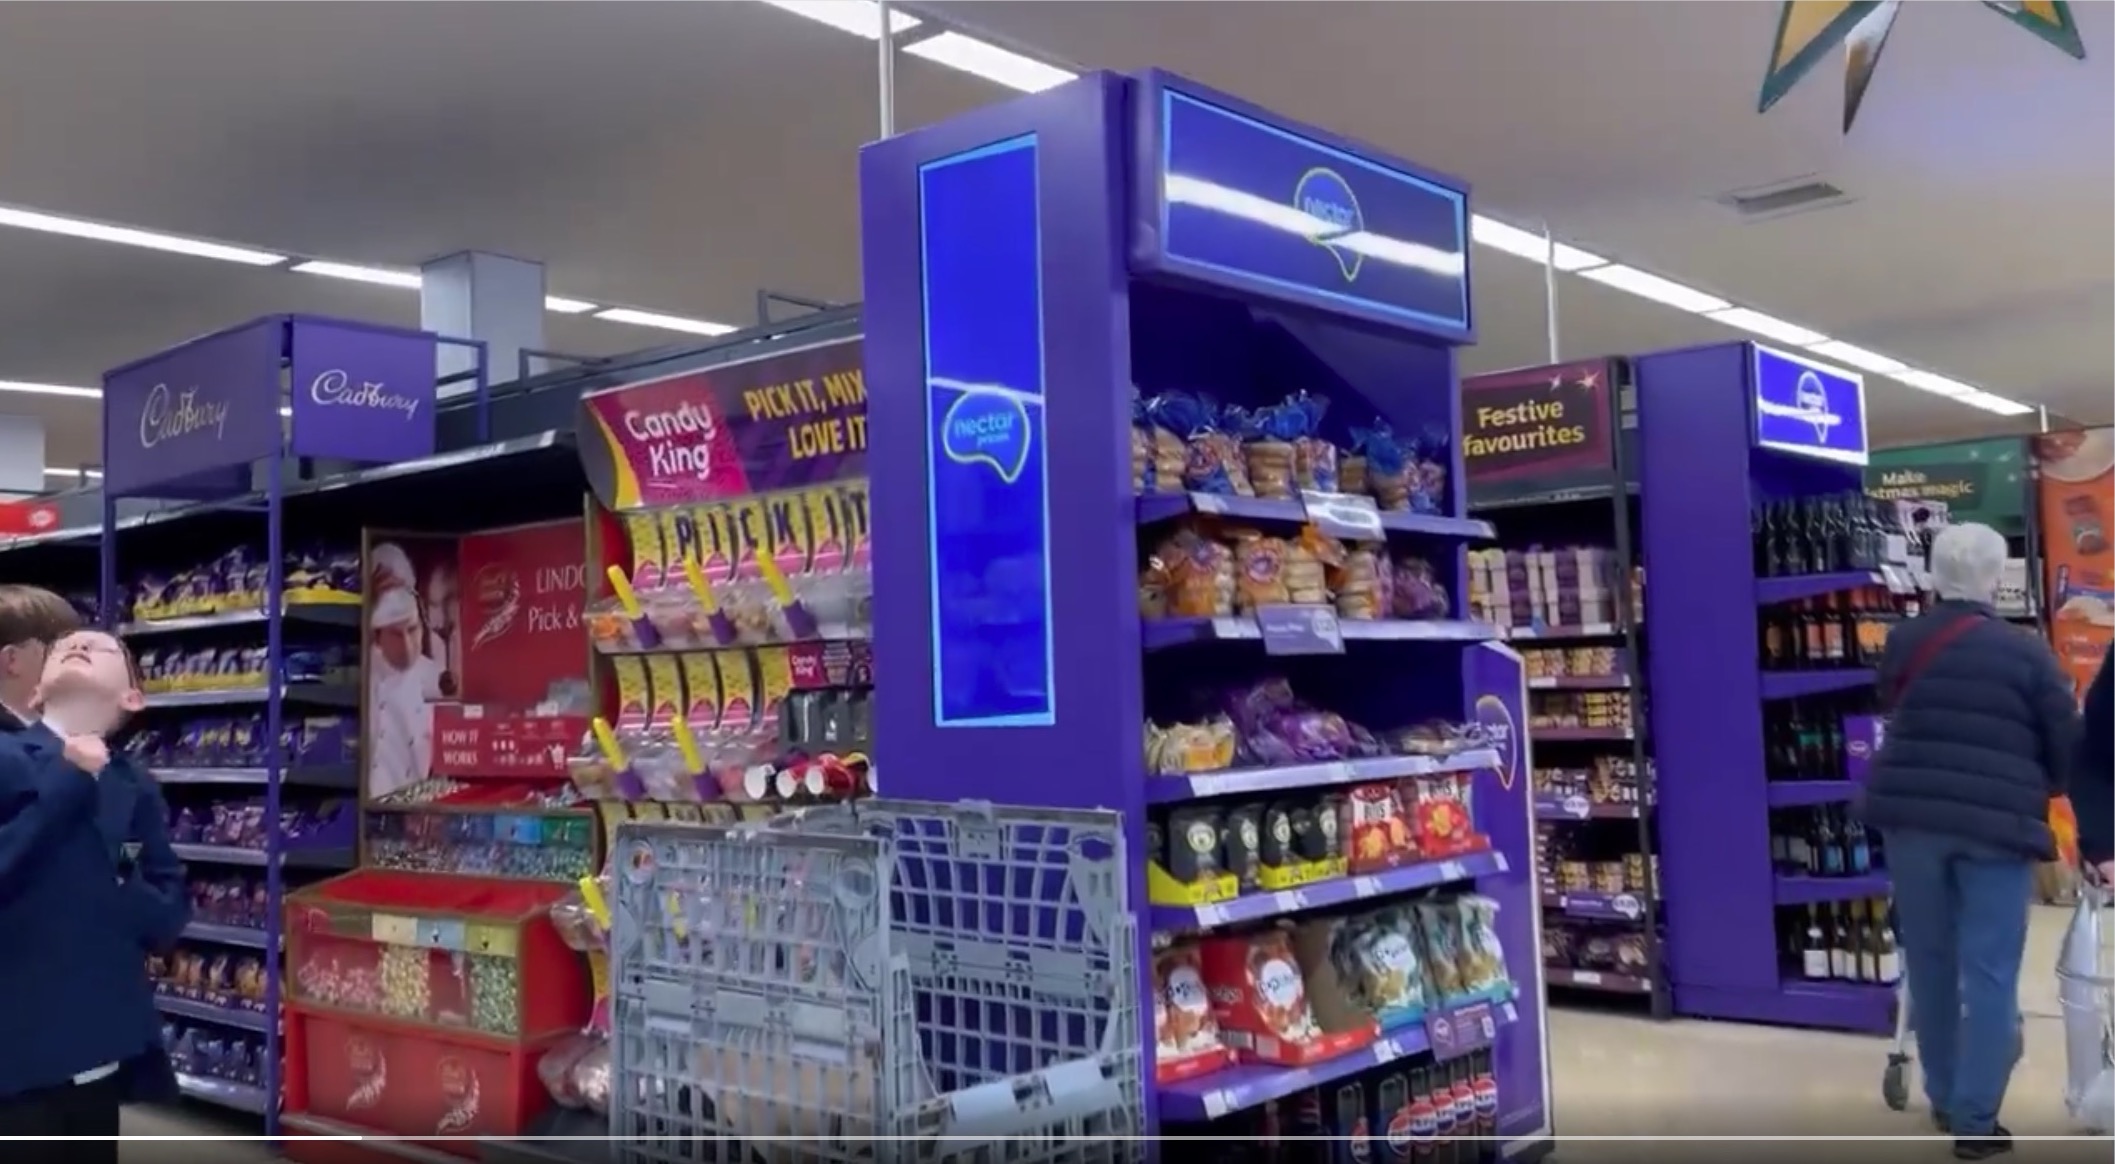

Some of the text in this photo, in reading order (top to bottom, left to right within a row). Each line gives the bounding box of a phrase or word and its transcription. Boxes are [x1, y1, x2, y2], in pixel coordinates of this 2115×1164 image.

[310, 368, 420, 421] Cadbury
[743, 369, 868, 422] PICK IT, MIX
[139, 382, 230, 449] Cadbury
[624, 401, 716, 443] Candy
[954, 411, 1013, 441] nectar
[1477, 399, 1565, 429] Festive
[788, 415, 867, 460] LOVE IT
[1461, 424, 1586, 457] favourites
[648, 442, 711, 482] King
[1882, 469, 1927, 486] Make
[1920, 479, 1975, 499] magic
[527, 606, 580, 634] Pick &
[441, 728, 479, 745] HOW IT
[442, 751, 478, 766] WORKS
